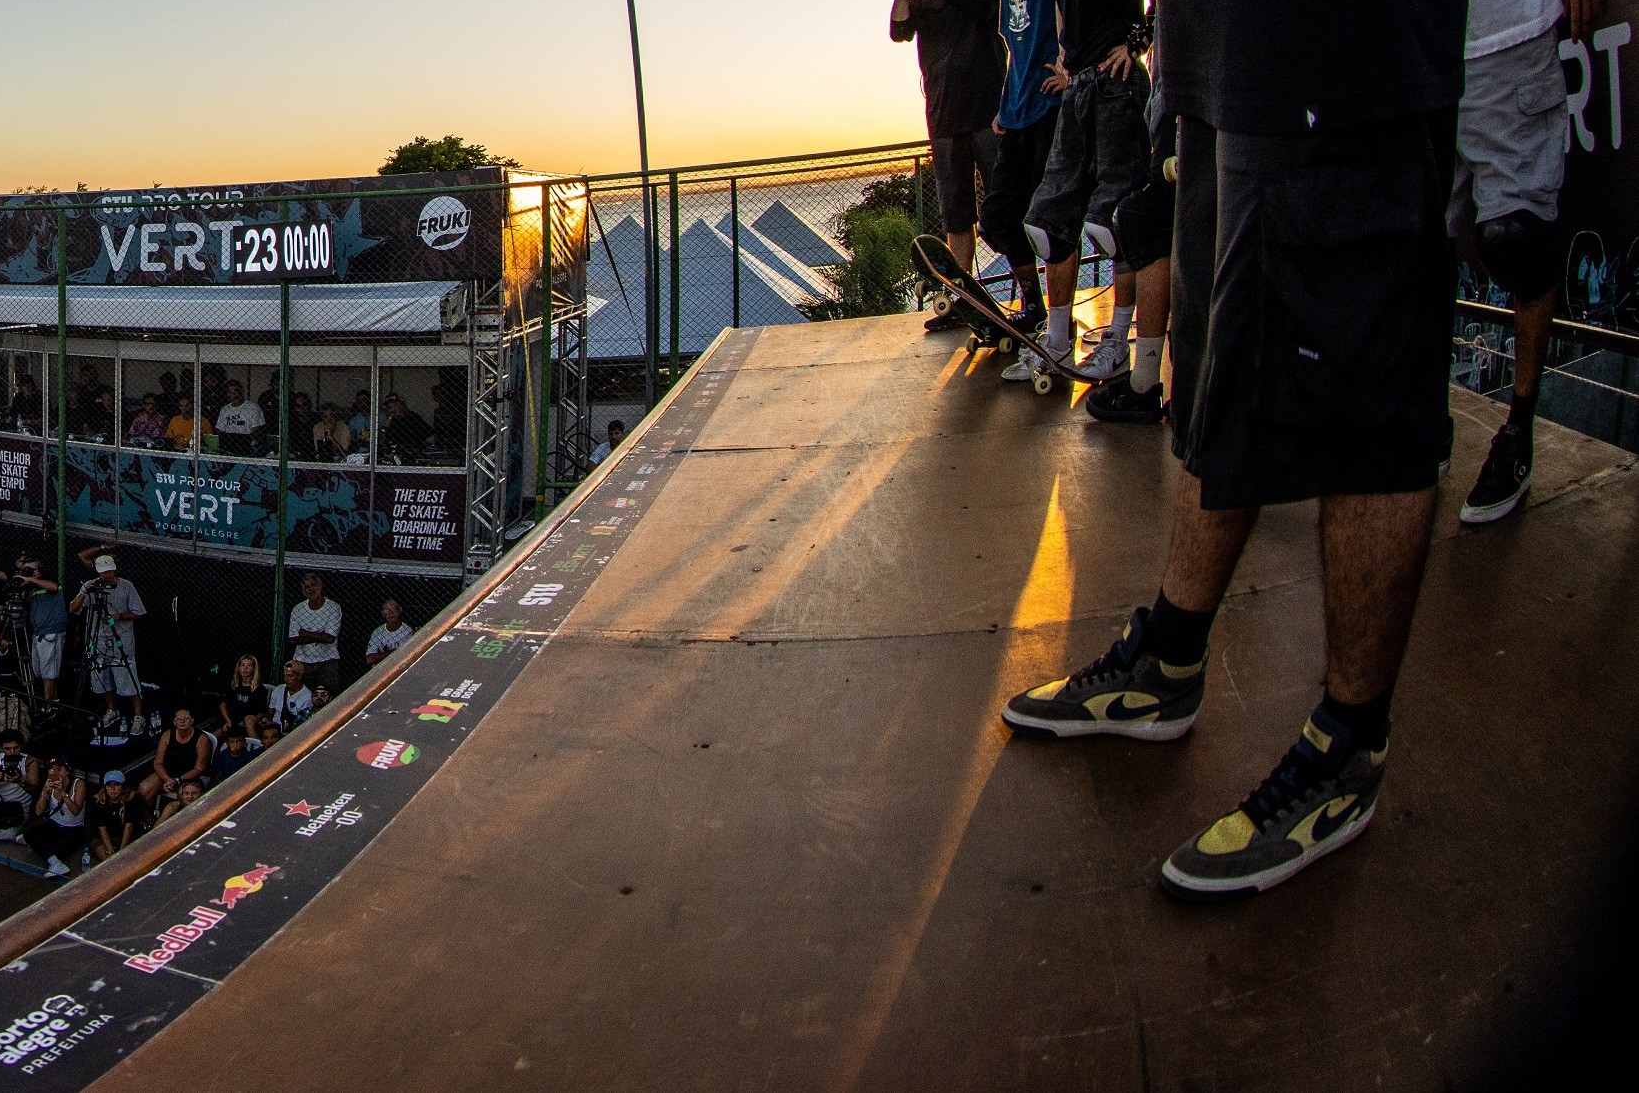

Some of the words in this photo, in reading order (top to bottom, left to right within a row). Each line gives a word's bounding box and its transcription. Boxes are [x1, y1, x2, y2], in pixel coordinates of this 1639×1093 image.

[142, 193, 182, 211] PRO
[187, 191, 244, 210] TOUR
[418, 211, 470, 235] FRUKI
[100, 220, 244, 271] VERT
[283, 223, 330, 271] 00:00
[1, 463, 28, 479] SKATE
[156, 473, 176, 485] STU
[180, 475, 206, 487] PRO
[208, 479, 241, 492] TOUR
[394, 488, 416, 503] THE
[417, 489, 448, 503] BEST
[155, 489, 240, 525] VERT
[392, 503, 408, 518] OF
[408, 505, 449, 519] SKATE-
[155, 521, 191, 533] PORTO
[197, 527, 240, 540] ALEGRE
[392, 519, 438, 535] BOARDIN
[438, 522, 458, 535] ALL
[392, 535, 414, 549] THE
[416, 537, 445, 551] TIME
[518, 583, 564, 605] STU
[460, 691, 474, 699] DO
[371, 739, 405, 770] FRUKI
[295, 793, 356, 837] Heineken
[124, 933, 187, 974] Red
[170, 905, 227, 942] Bull
[22, 1013, 114, 1075] PREFEITURA
